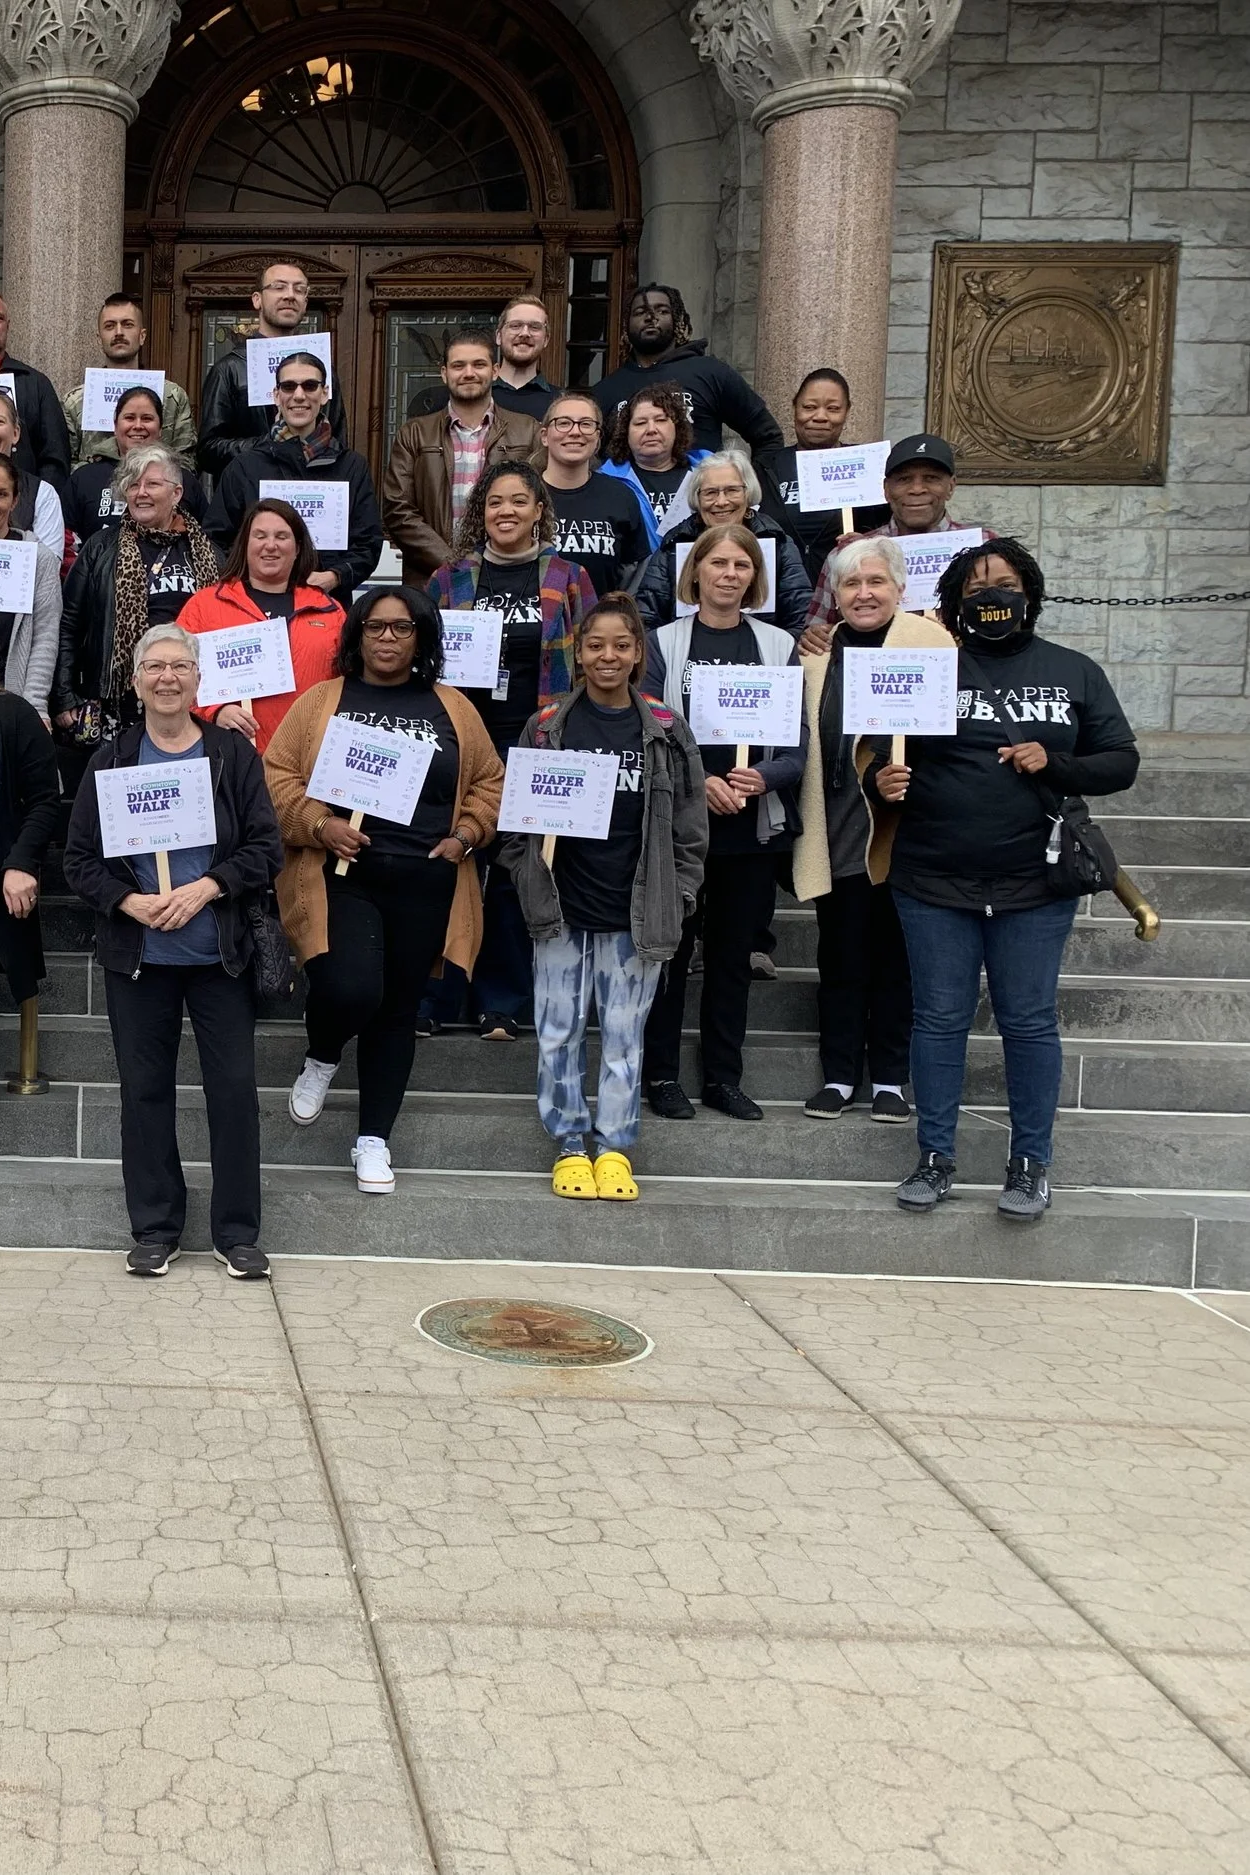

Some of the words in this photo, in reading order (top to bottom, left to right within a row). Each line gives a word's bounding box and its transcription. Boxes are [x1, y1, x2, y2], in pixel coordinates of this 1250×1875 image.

[821, 463, 865, 474] DIAPER
[821, 472, 856, 482] WALK
[980, 608, 1012, 622] DOULA
[216, 644, 262, 660] DIAPER
[217, 655, 254, 670] WALK
[871, 673, 924, 684] DIAPER
[718, 688, 770, 698] DIAPER
[871, 684, 913, 695] WALK
[718, 698, 759, 708] WALK
[351, 739, 365, 748] THE
[346, 746, 398, 770] DIAPER
[345, 757, 385, 777] WALK
[533, 766, 548, 774] THE
[141, 780, 180, 790] DOWNTOWN
[531, 773, 584, 787] DIAPER
[126, 787, 181, 804] DIAPER
[530, 784, 572, 797] WALK
[127, 800, 171, 814] WALK
